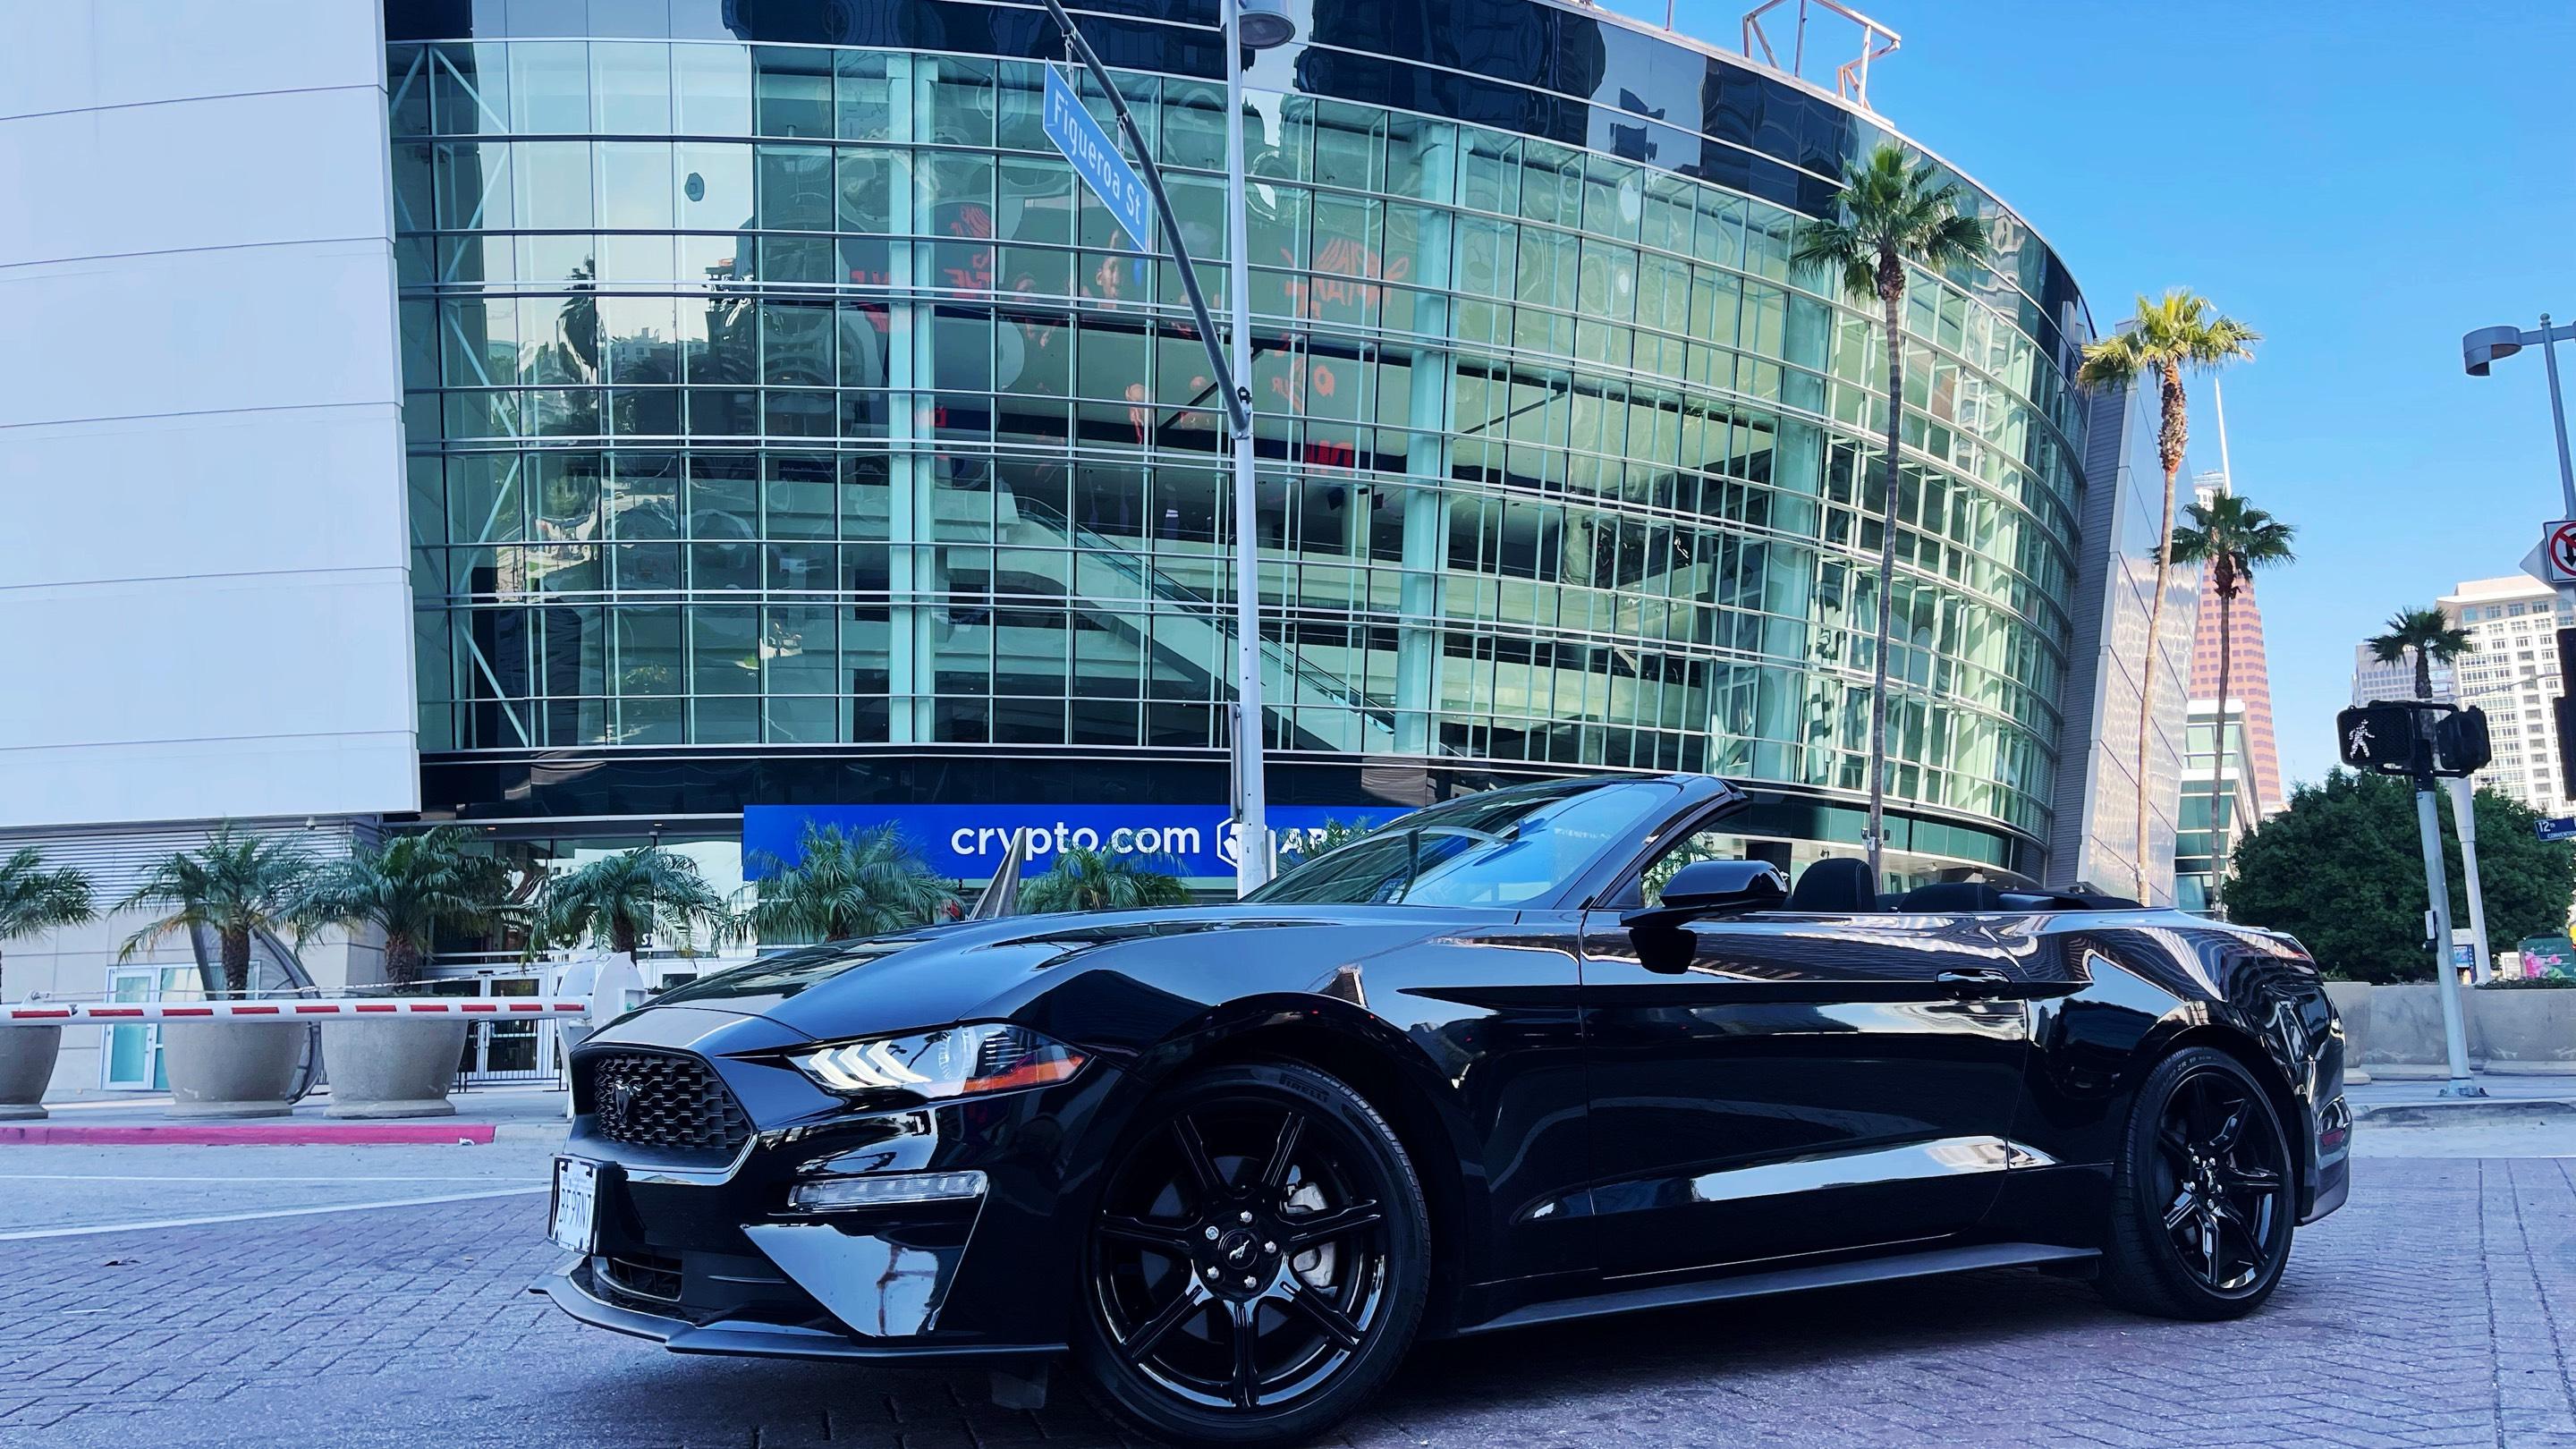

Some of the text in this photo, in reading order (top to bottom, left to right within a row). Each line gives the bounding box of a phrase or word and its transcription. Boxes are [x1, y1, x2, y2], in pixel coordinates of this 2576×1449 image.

[1054, 89, 1140, 225] Figueroa St
[951, 822, 1200, 860] crypto.com
